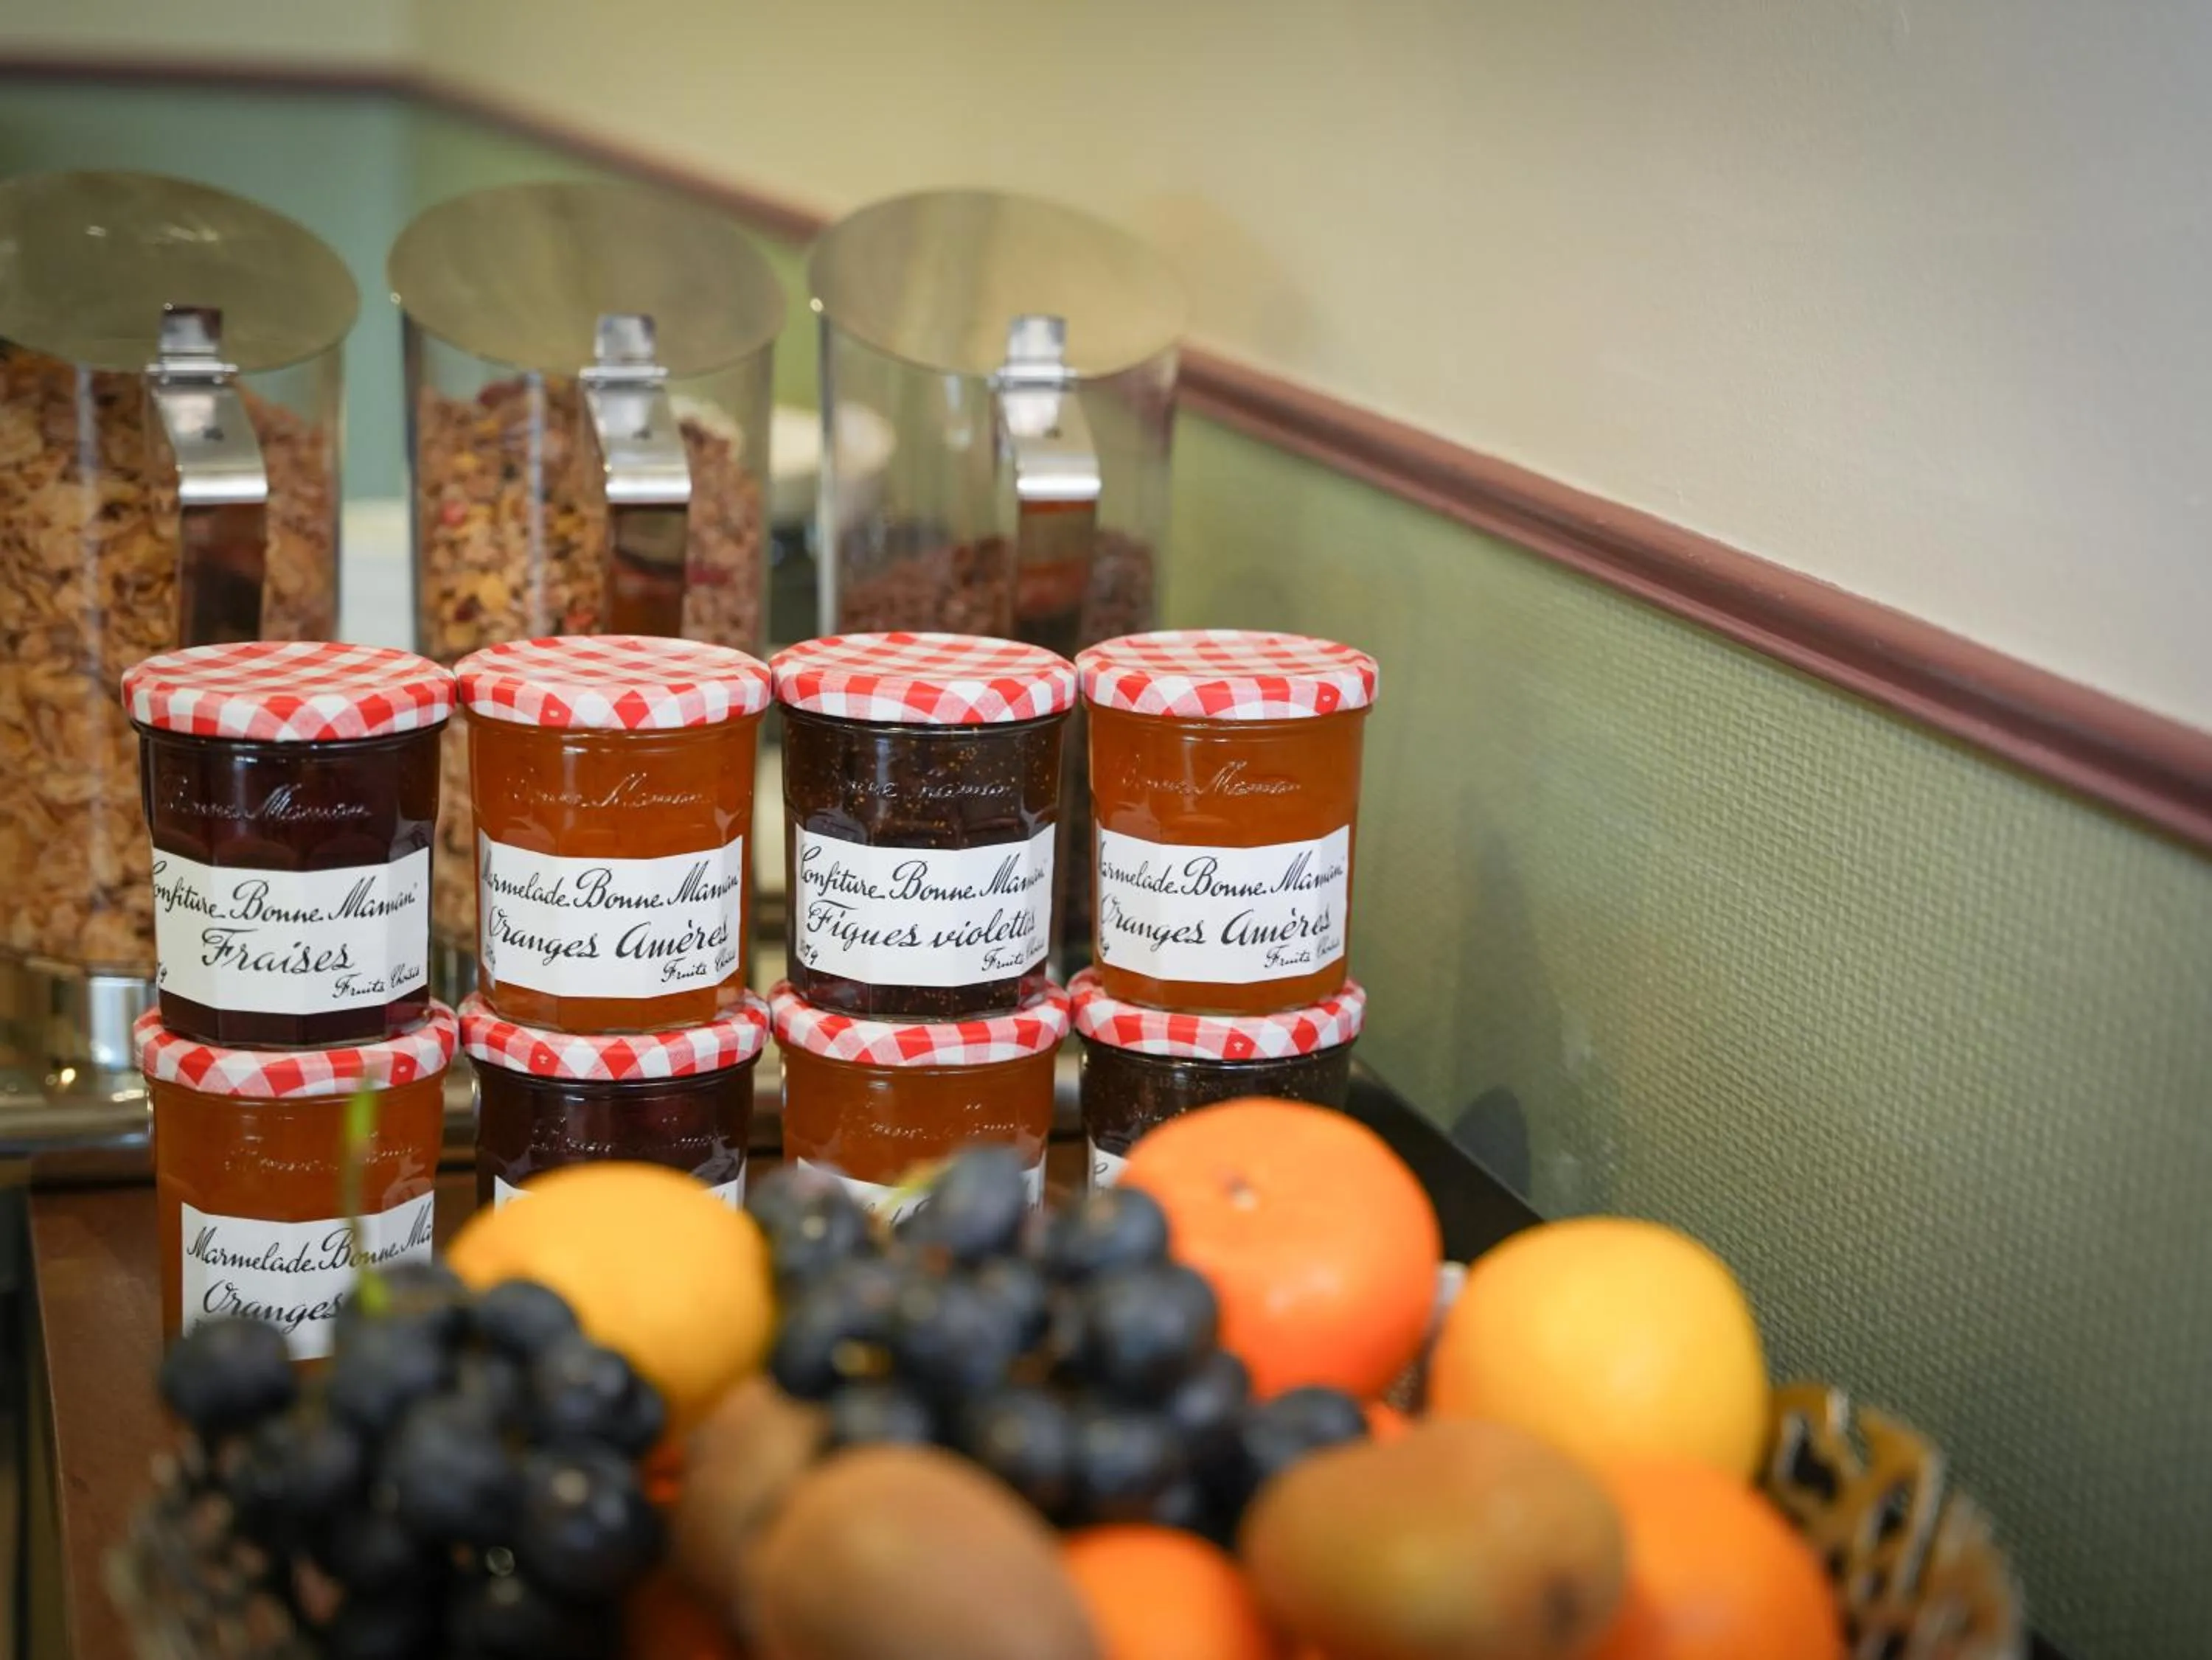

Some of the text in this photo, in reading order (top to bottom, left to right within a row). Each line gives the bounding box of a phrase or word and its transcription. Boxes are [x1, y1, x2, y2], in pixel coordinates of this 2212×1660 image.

[574, 868, 664, 910] Bonne
[667, 859, 738, 905] Maman
[801, 845, 885, 899] Confiture
[888, 860, 975, 902] Bonne
[1180, 856, 1266, 897] Bonne
[1270, 850, 1343, 893] Maman
[229, 879, 324, 923] Bonne
[328, 875, 415, 921] Maman
[1101, 893, 1207, 952] Oranges
[1220, 904, 1330, 946] Amères
[489, 906, 601, 966] Oranges
[615, 915, 728, 959] Amères
[807, 899, 922, 952] Figues
[201, 927, 355, 973] Fraises
[661, 956, 706, 983] Fruits
[981, 947, 1023, 972] Fruits
[1265, 944, 1310, 968] Fruits
[333, 972, 385, 998] Fruits
[187, 1226, 399, 1274] Marmelade Bonne
[203, 1278, 344, 1334] Oranges
